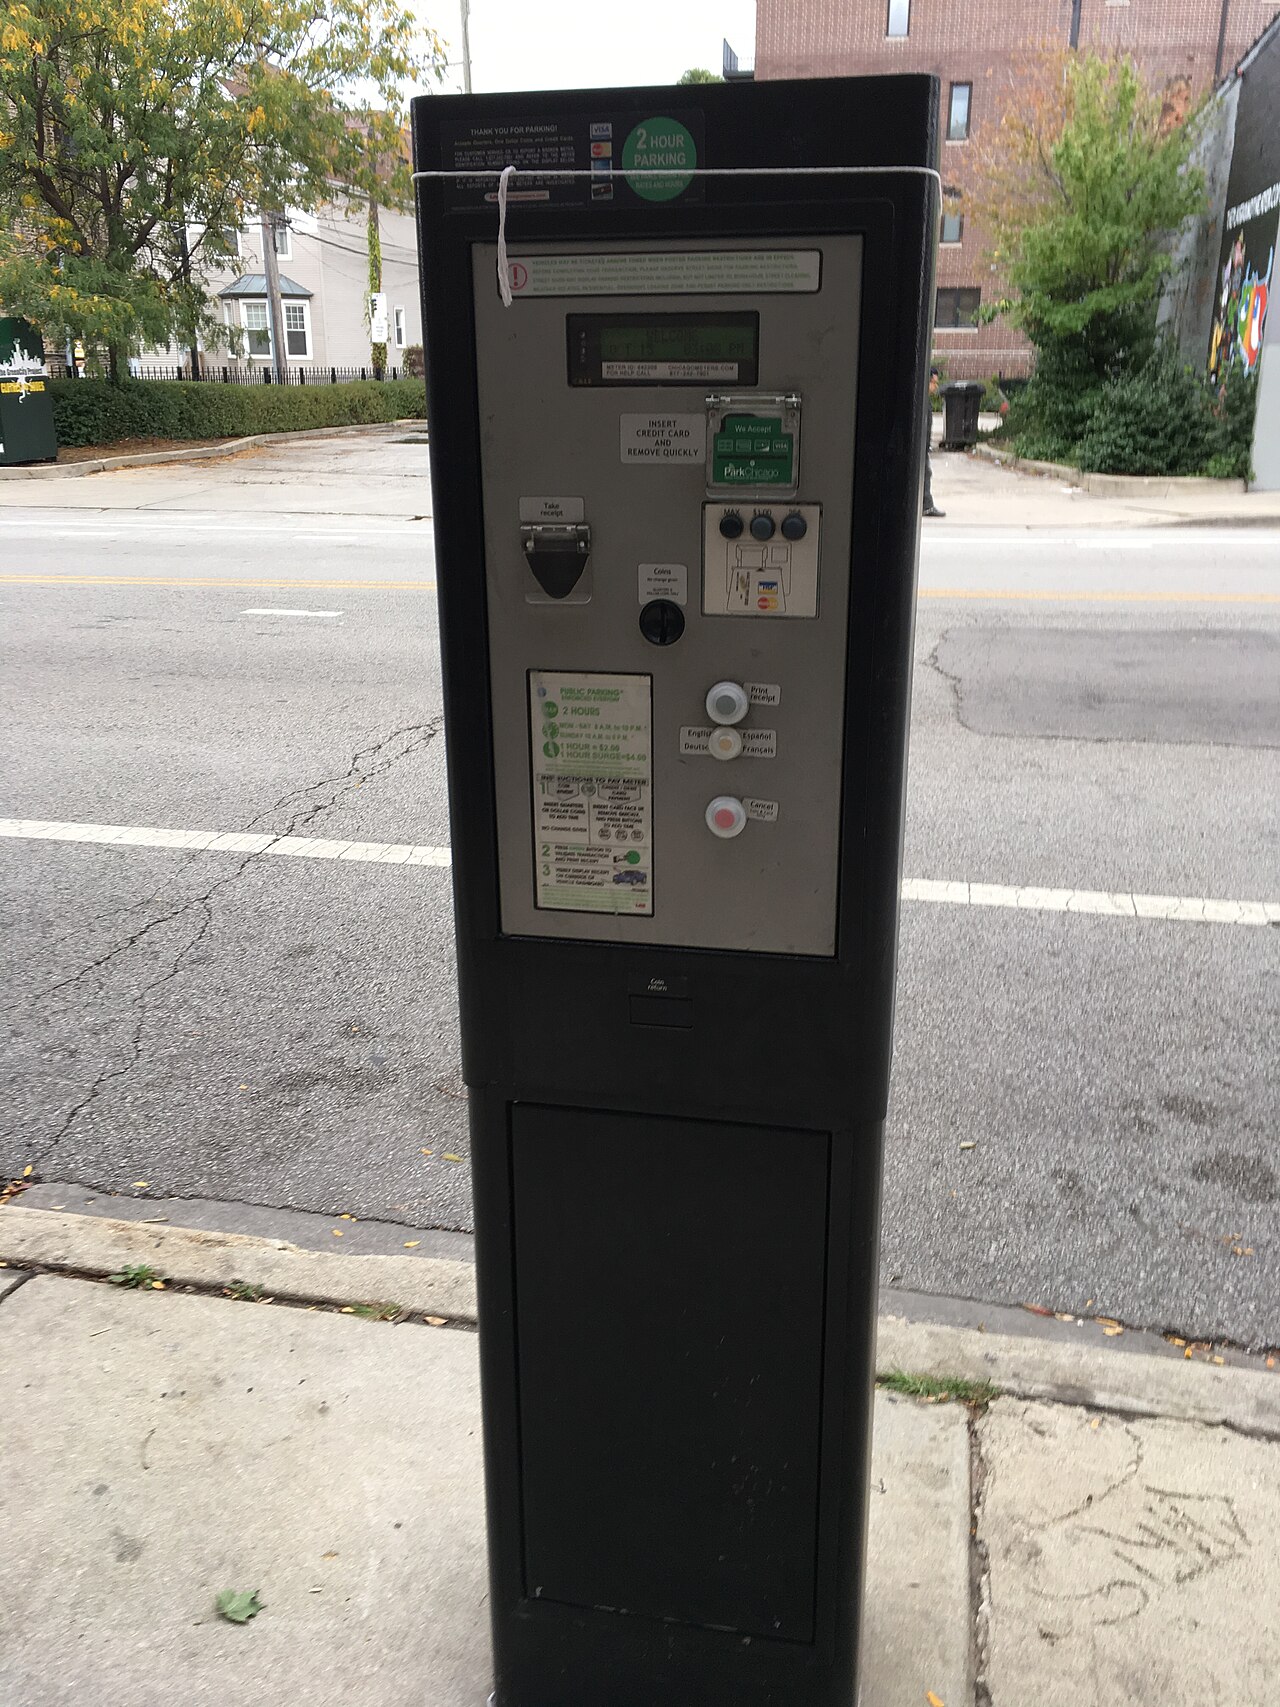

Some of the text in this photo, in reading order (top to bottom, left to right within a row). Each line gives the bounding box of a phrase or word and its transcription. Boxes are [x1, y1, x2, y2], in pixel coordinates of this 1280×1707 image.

[636, 128, 684, 148] 2 HOUR
[634, 152, 686, 166] PARKING
[748, 425, 772, 433] Accept
[664, 449, 699, 457] QUICKLY
[571, 707, 600, 716] HOURS
[688, 729, 712, 738] Englis
[742, 746, 774, 754] Français
[750, 801, 774, 810] Cancel
[542, 845, 550, 857] 2
[542, 864, 550, 876] 3
